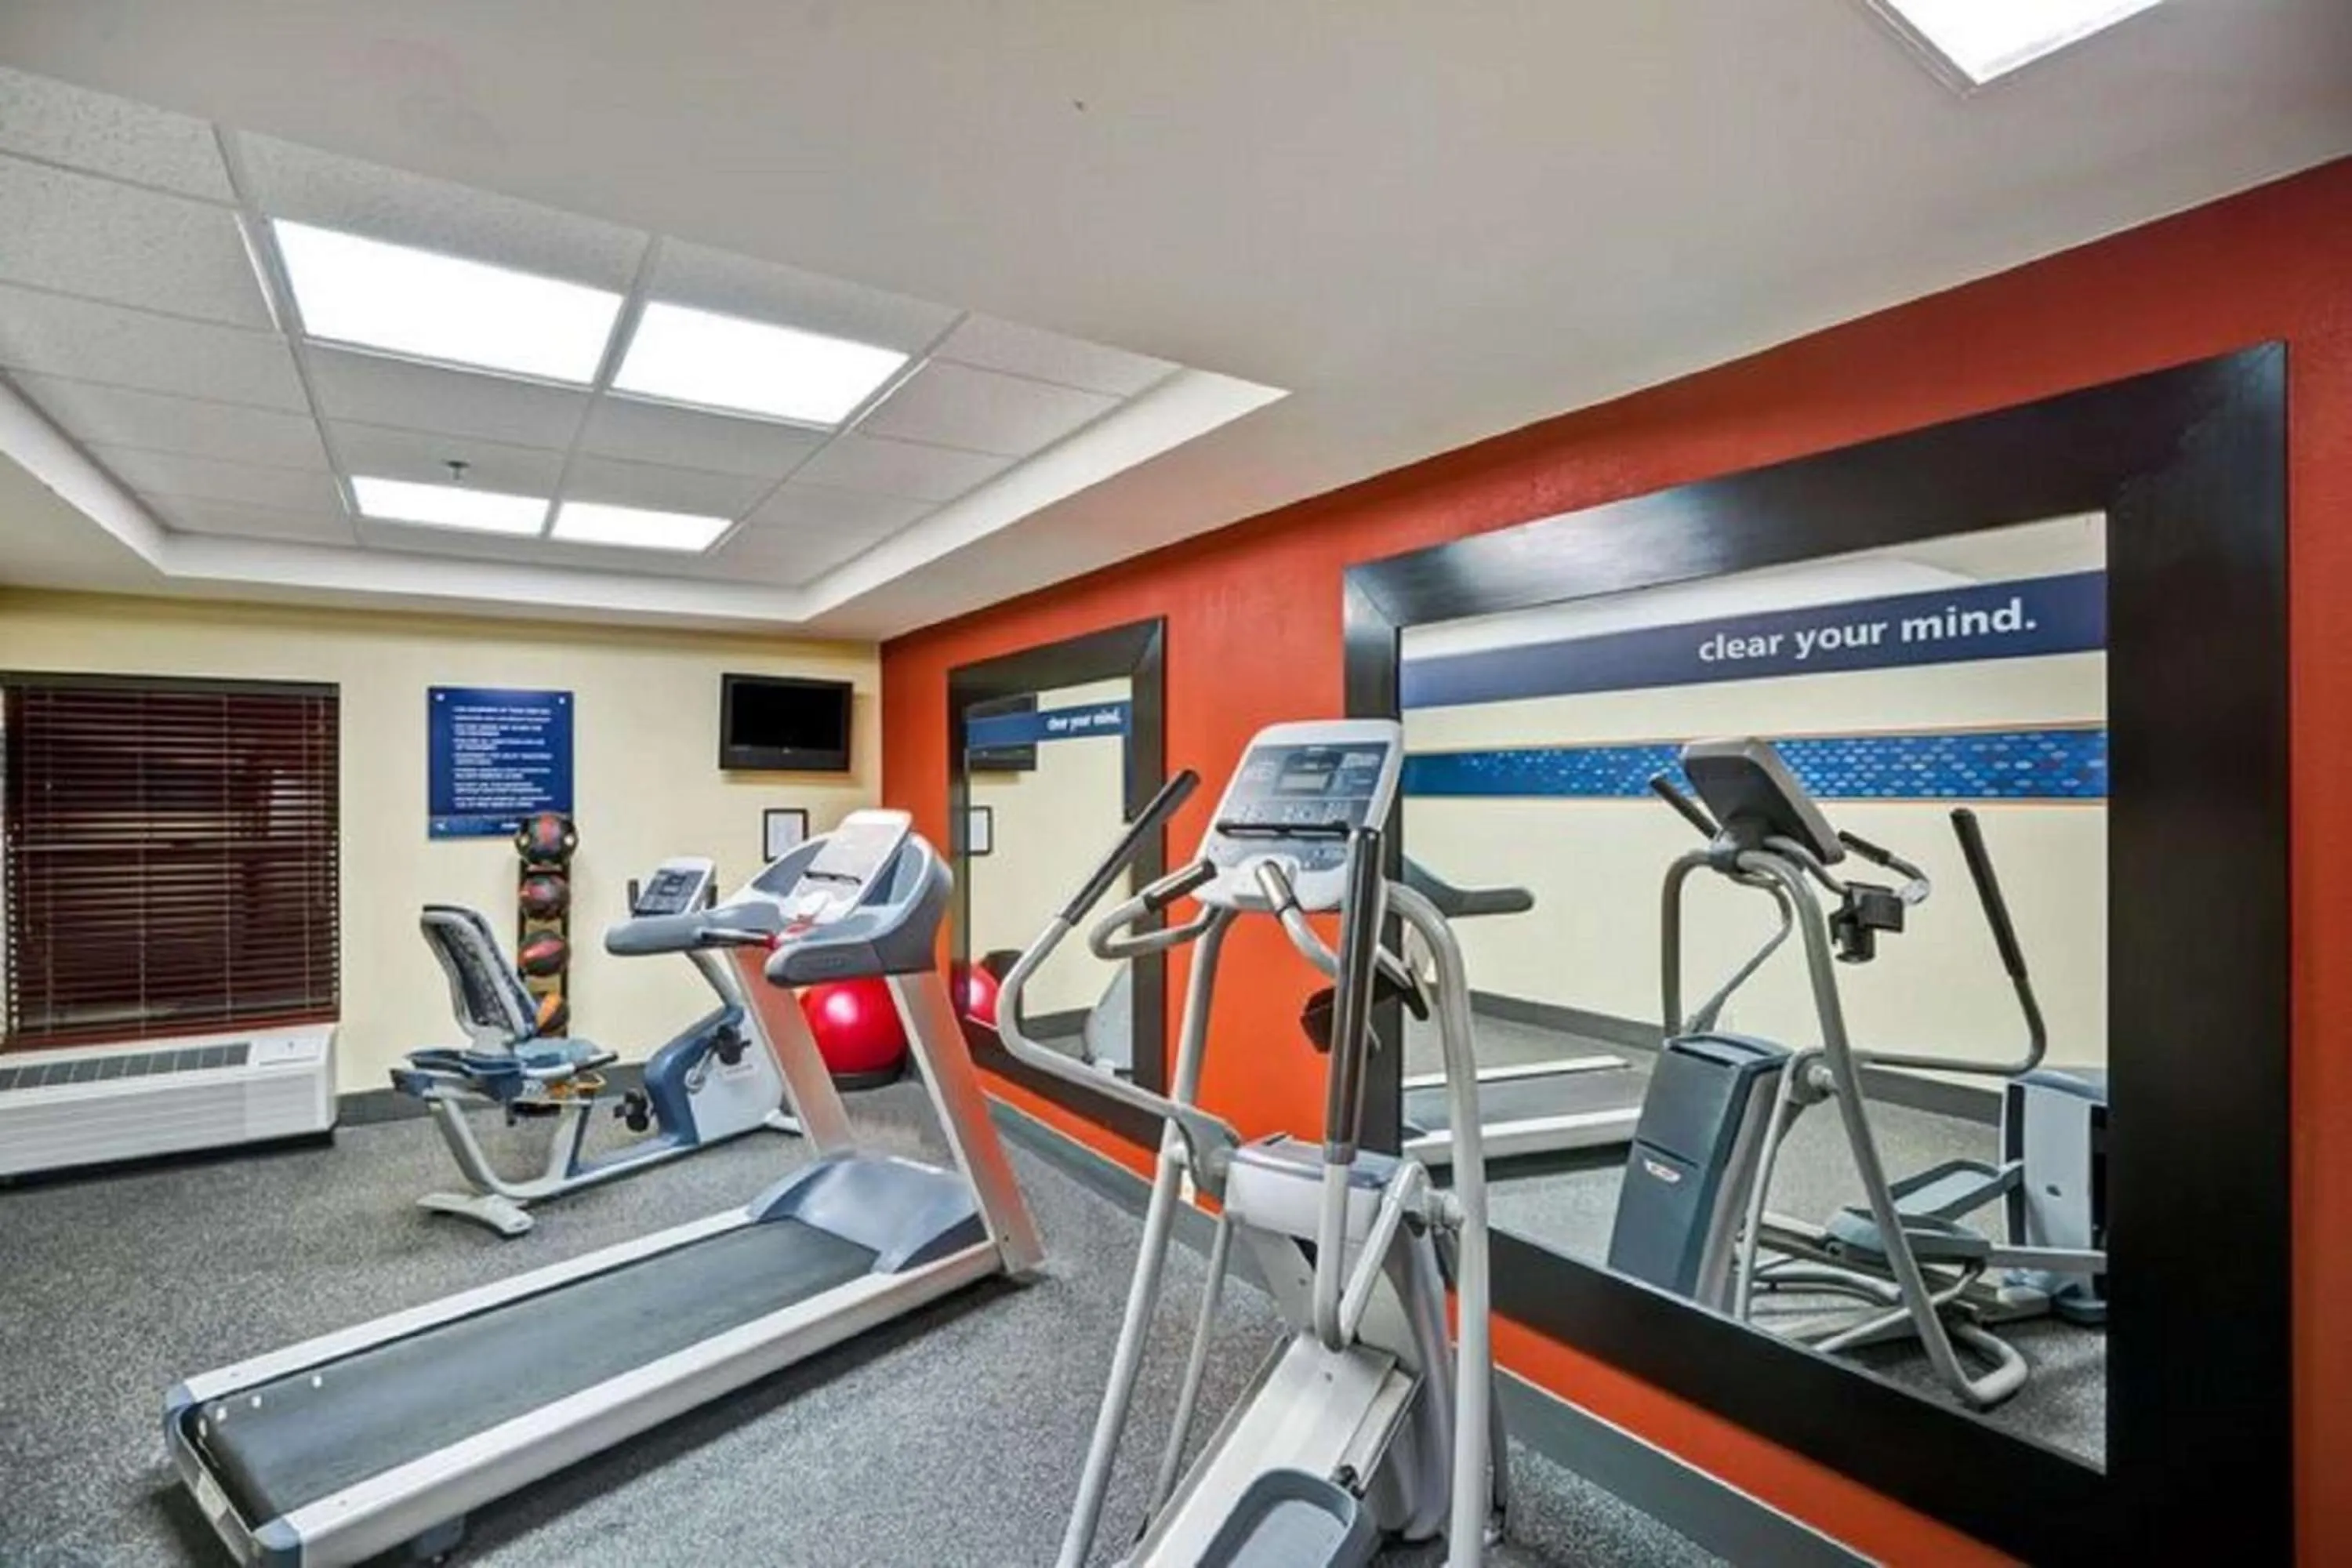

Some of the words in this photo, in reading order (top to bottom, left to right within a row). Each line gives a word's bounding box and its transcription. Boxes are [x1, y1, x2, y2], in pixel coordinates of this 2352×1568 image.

[1698, 631, 1784, 662] clear
[1795, 620, 1888, 659] your
[1900, 597, 2038, 643] mind.
